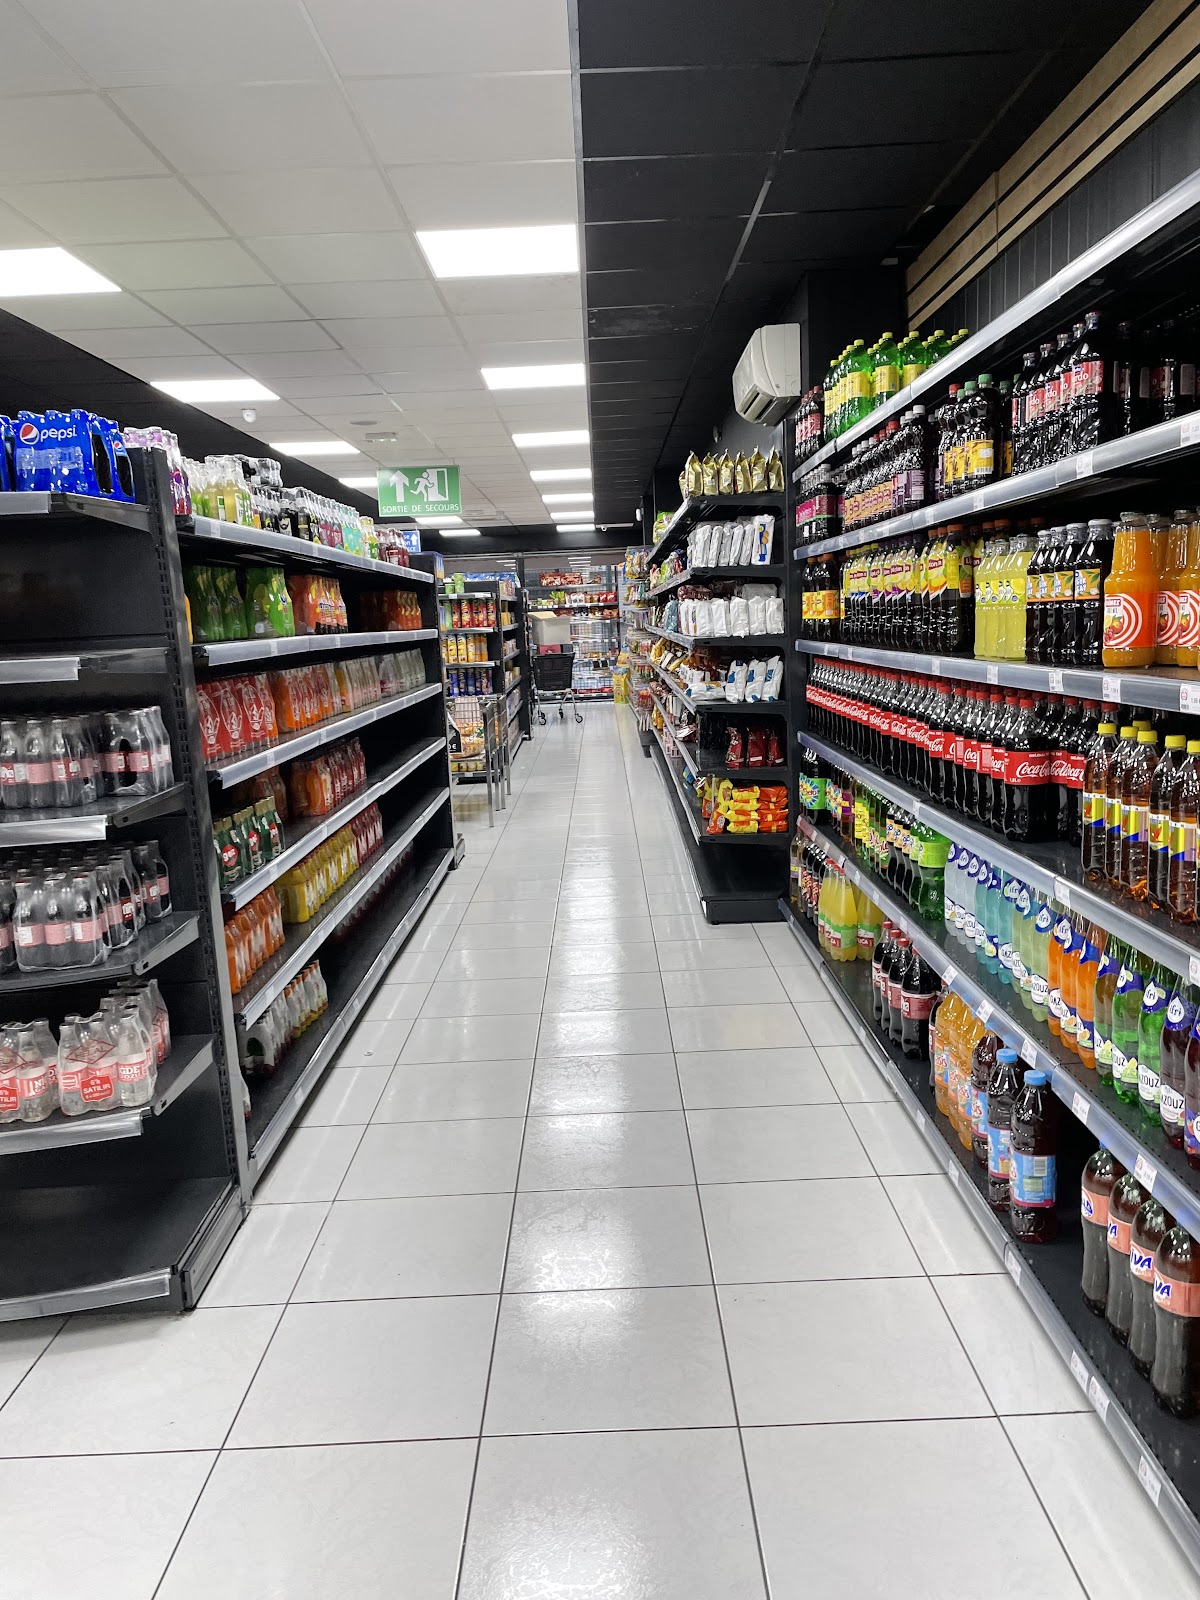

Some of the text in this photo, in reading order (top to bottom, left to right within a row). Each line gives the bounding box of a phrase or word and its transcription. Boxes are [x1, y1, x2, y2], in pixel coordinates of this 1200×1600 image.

[40, 424, 77, 442] pepsi
[382, 503, 460, 513] SORTIE DE SECOURS
[83, 1083, 111, 1094] SATILIR
